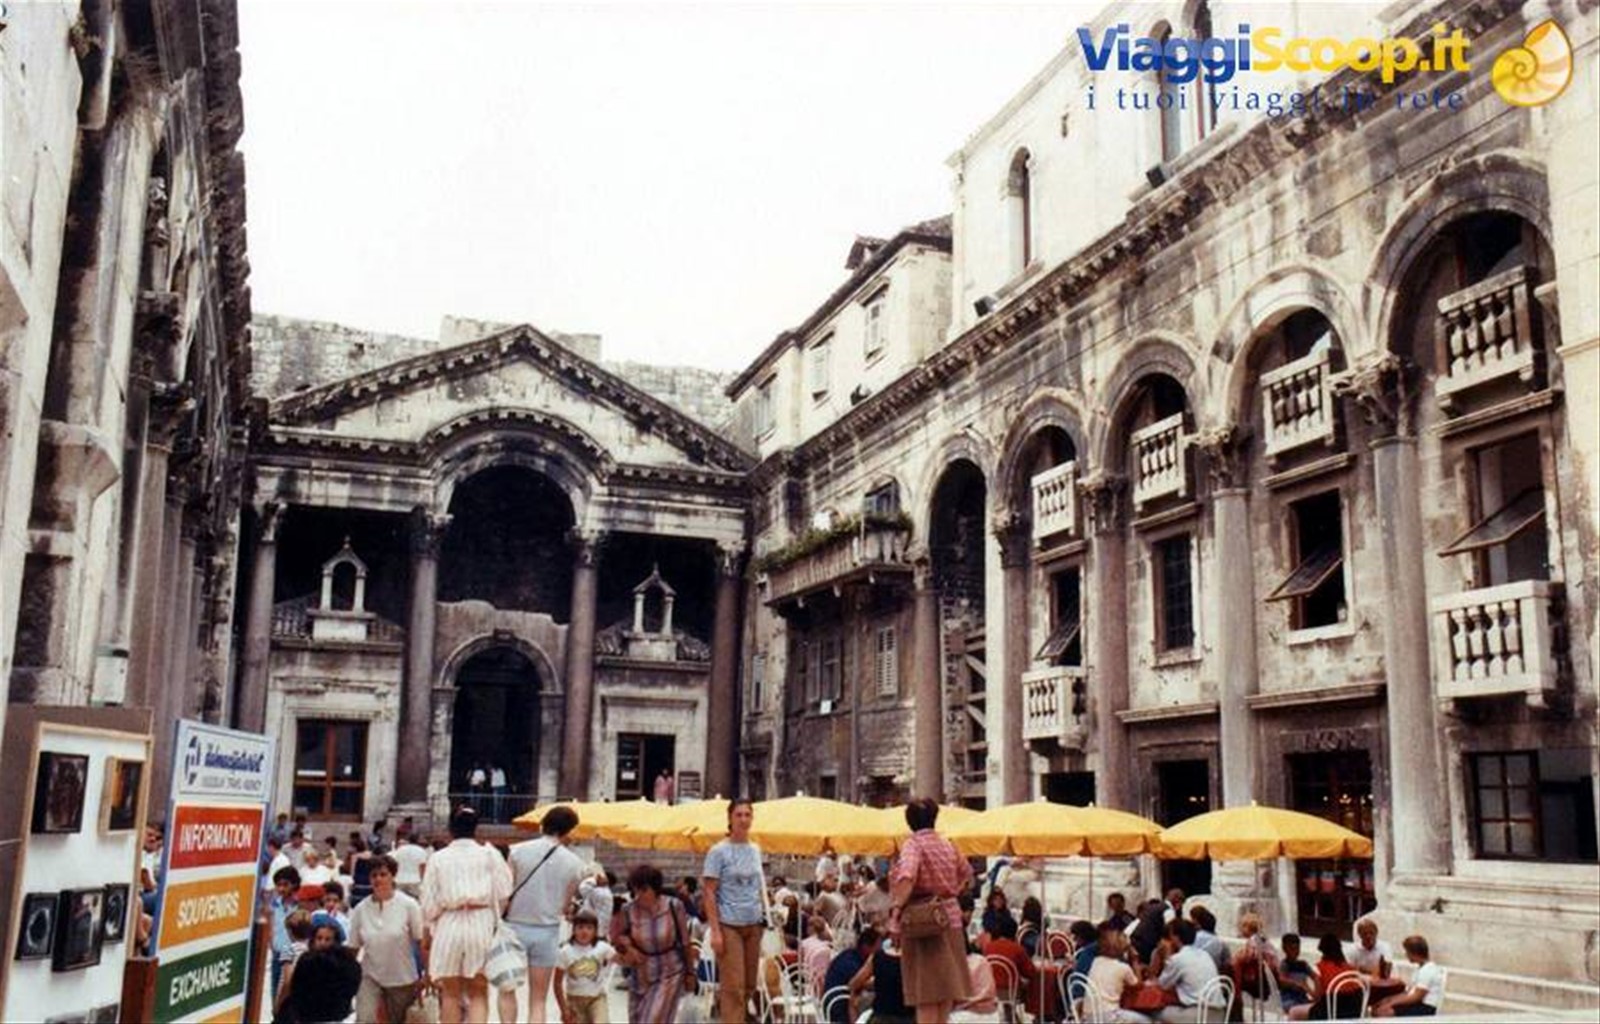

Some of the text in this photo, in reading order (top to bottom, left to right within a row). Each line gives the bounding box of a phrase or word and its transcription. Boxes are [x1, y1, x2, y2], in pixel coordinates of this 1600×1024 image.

[179, 823, 254, 853] INFORMATION
[176, 891, 240, 930] SOUVENIRS
[169, 957, 233, 1007] EXCHANGE
